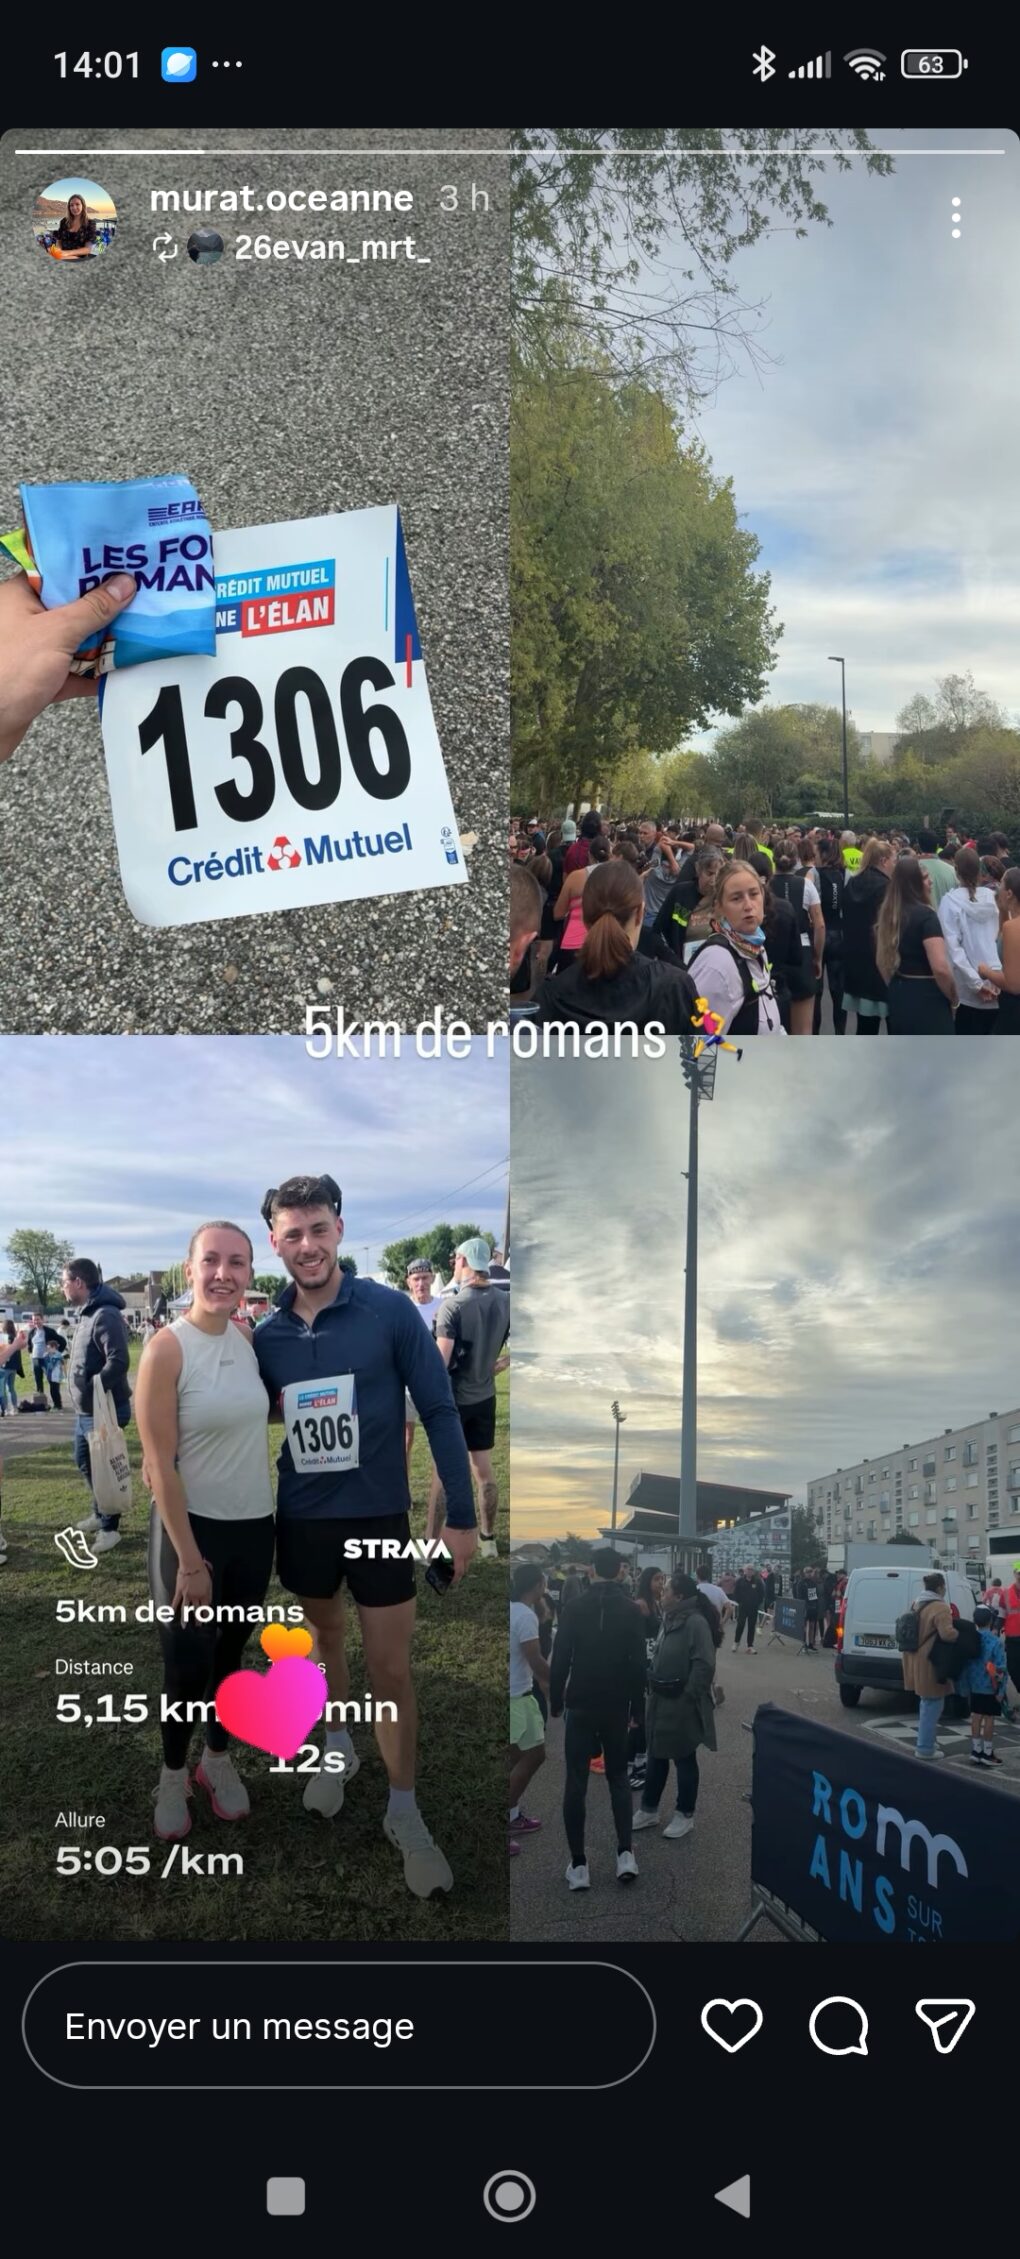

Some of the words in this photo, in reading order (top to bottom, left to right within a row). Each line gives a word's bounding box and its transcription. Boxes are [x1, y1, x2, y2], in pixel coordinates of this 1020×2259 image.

[82, 544, 148, 574] LES
[79, 564, 216, 597] RMAN
[216, 577, 263, 599] RÉDIT
[266, 568, 330, 592] MUTUEL
[215, 609, 237, 628] NE
[138, 656, 411, 832] 1306
[168, 846, 265, 886] Crédit
[303, 823, 413, 866] Mutuel
[292, 1413, 353, 1454] 1306
[907, 1894, 944, 1940] SUR
